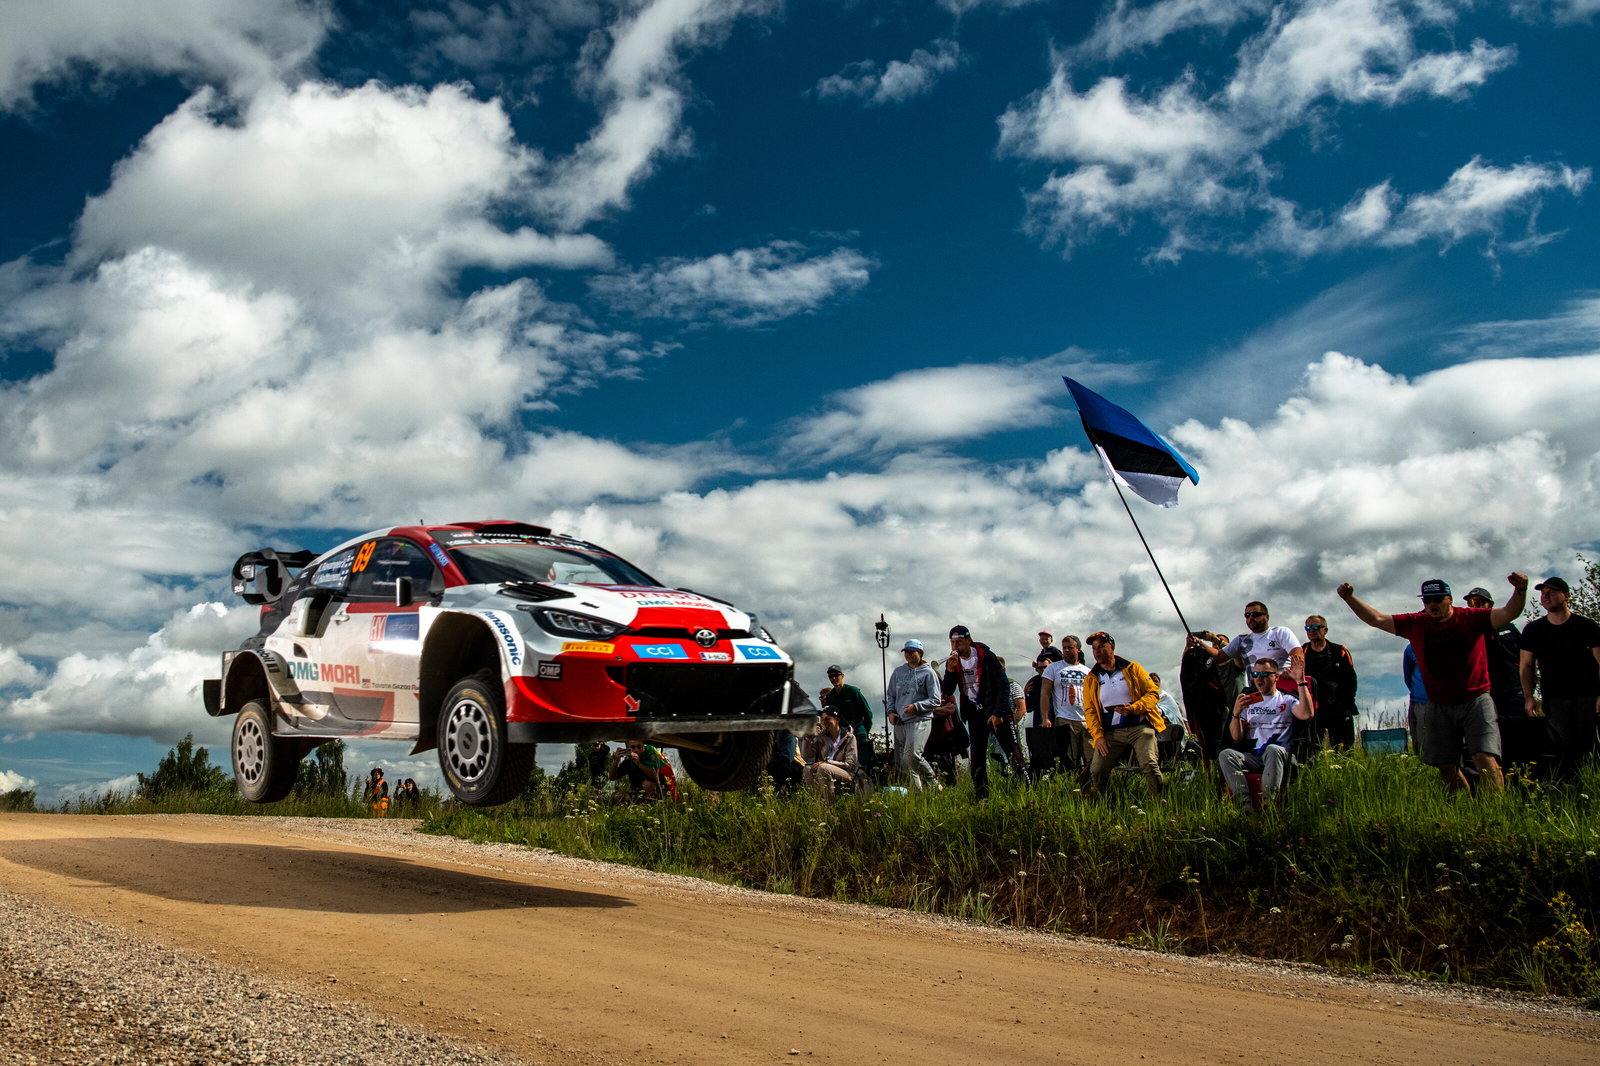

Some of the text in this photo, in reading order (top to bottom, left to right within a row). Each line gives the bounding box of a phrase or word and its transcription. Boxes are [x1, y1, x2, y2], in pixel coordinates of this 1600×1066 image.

[351, 541, 377, 573] 69
[619, 592, 702, 601] DENSO
[482, 610, 522, 666] Panasonic
[287, 661, 319, 681] DMG
[320, 663, 360, 684] MORI
[540, 666, 561, 676] OMP
